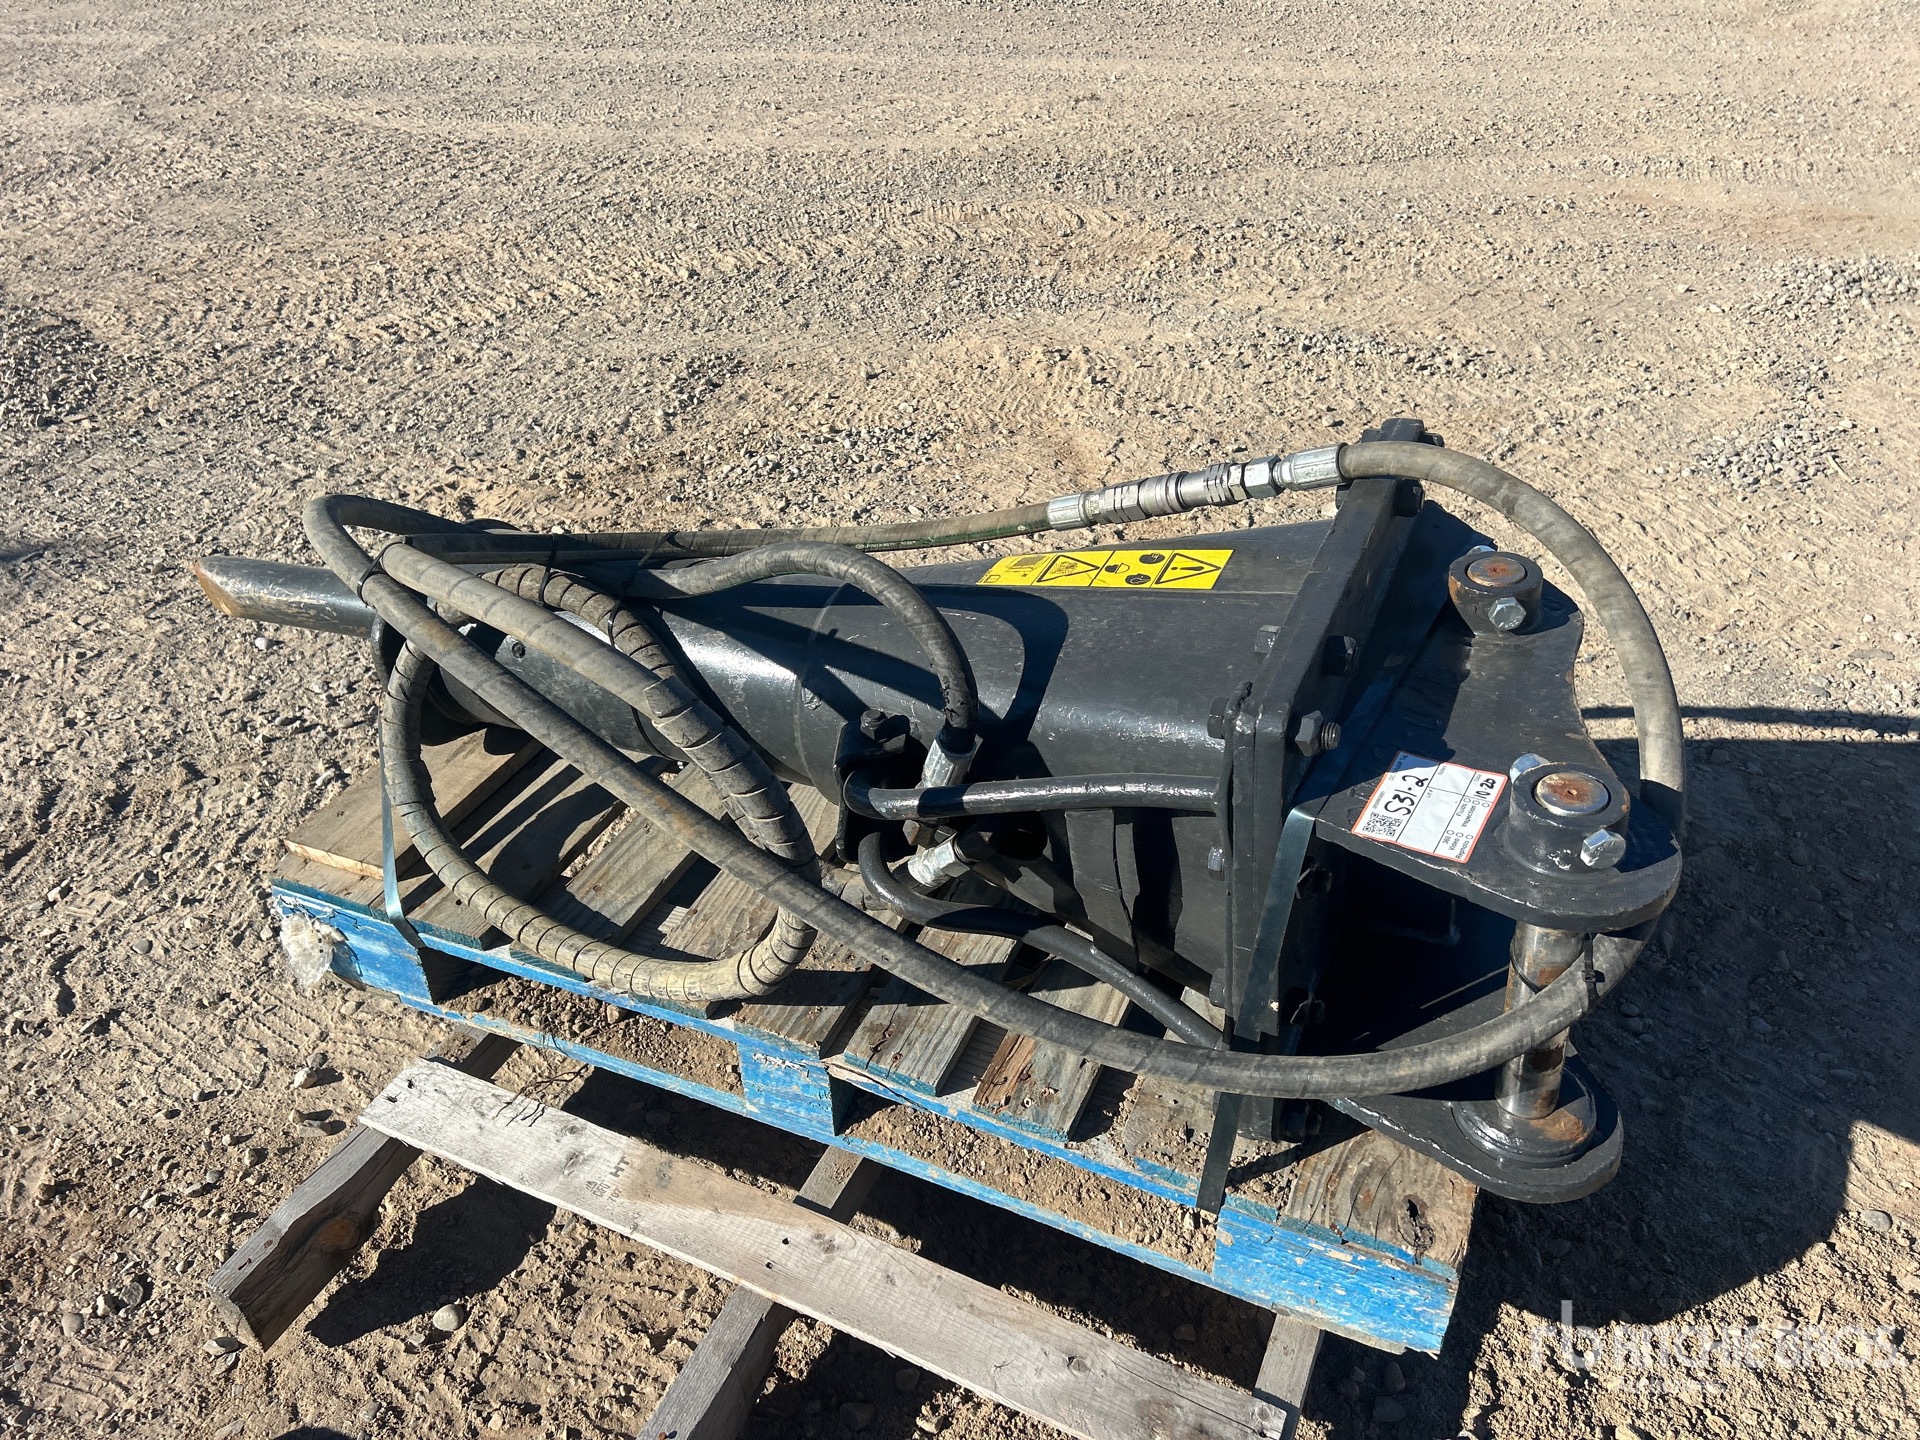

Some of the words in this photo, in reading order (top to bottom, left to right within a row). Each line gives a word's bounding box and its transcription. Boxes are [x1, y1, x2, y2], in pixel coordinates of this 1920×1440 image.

[1456, 803, 1468, 816] Fluids
[1460, 805, 1477, 827] Inspection
[1448, 837, 1460, 850] Video
[609, 1156, 630, 1178] HT
